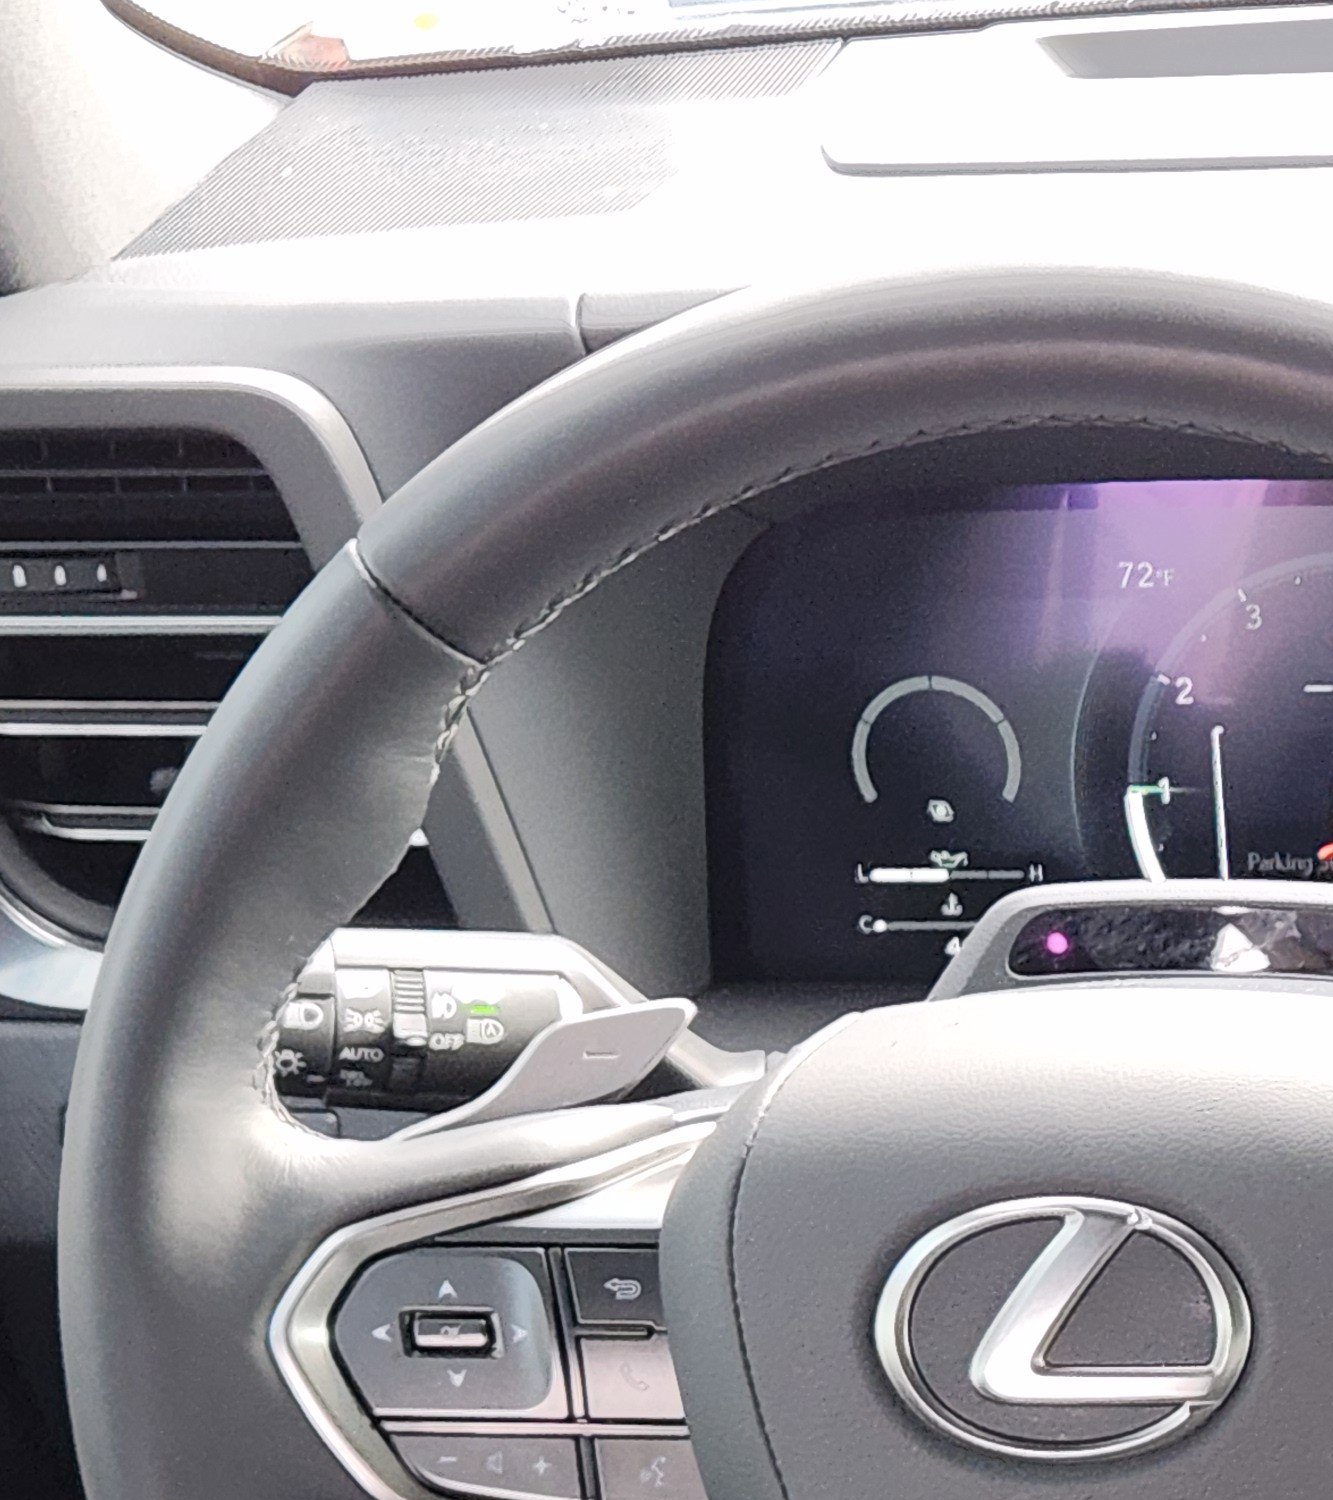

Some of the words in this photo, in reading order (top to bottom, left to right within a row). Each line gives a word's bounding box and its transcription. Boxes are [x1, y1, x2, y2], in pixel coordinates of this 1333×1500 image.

[1245, 604, 1262, 630] 3
[1175, 677, 1194, 705] 2
[1028, 863, 1044, 882] H
[1248, 852, 1313, 876] Parking
[429, 1031, 465, 1050] OFF
[338, 1046, 384, 1062] AUTO
